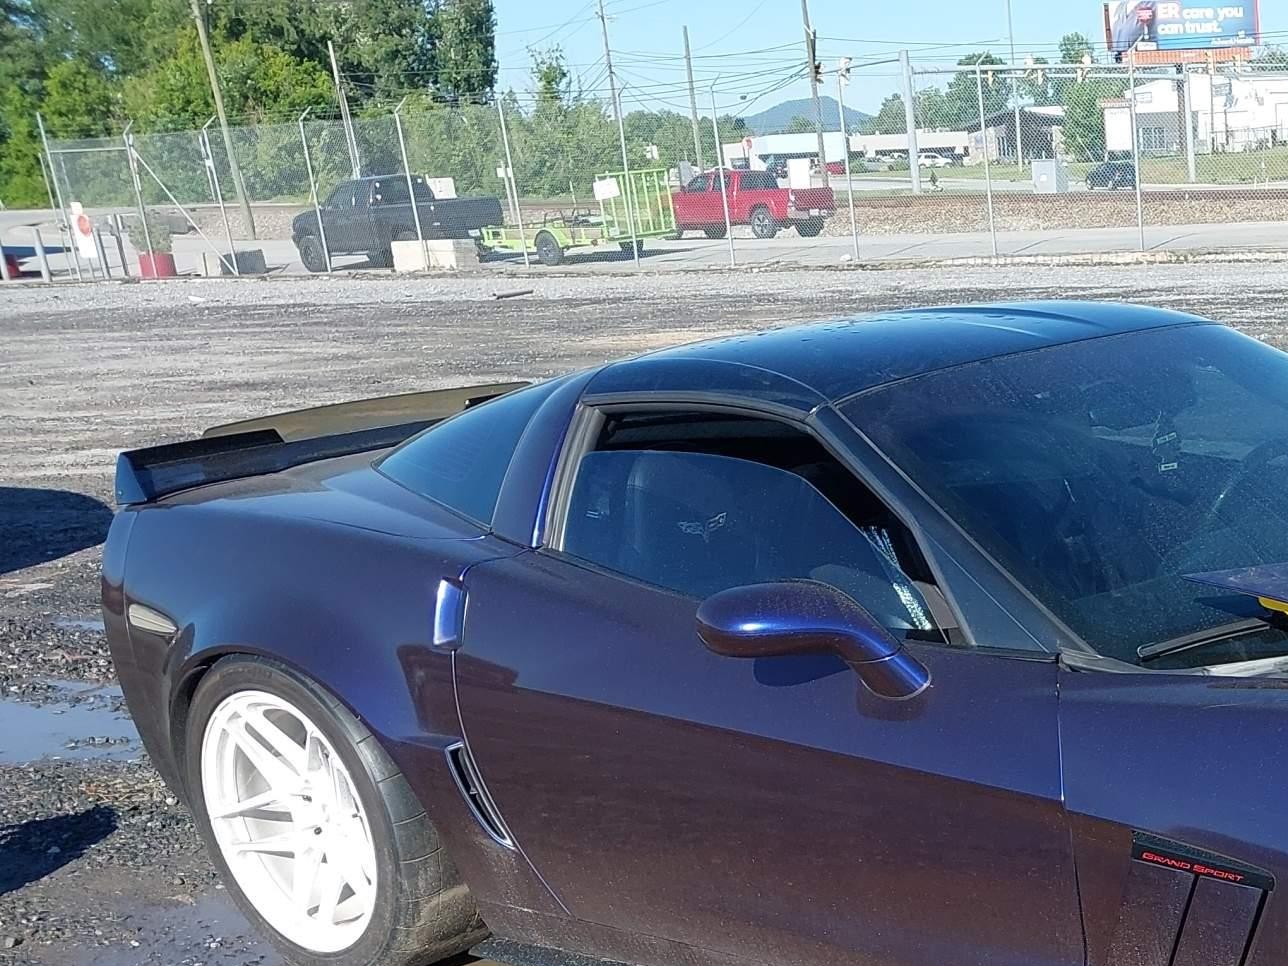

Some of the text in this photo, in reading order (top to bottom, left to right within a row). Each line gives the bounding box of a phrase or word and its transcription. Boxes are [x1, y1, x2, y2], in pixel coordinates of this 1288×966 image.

[1157, 3, 1244, 22] ER care you
[1157, 23, 1184, 35] can
[1141, 851, 1245, 881] GRAND SPORT
